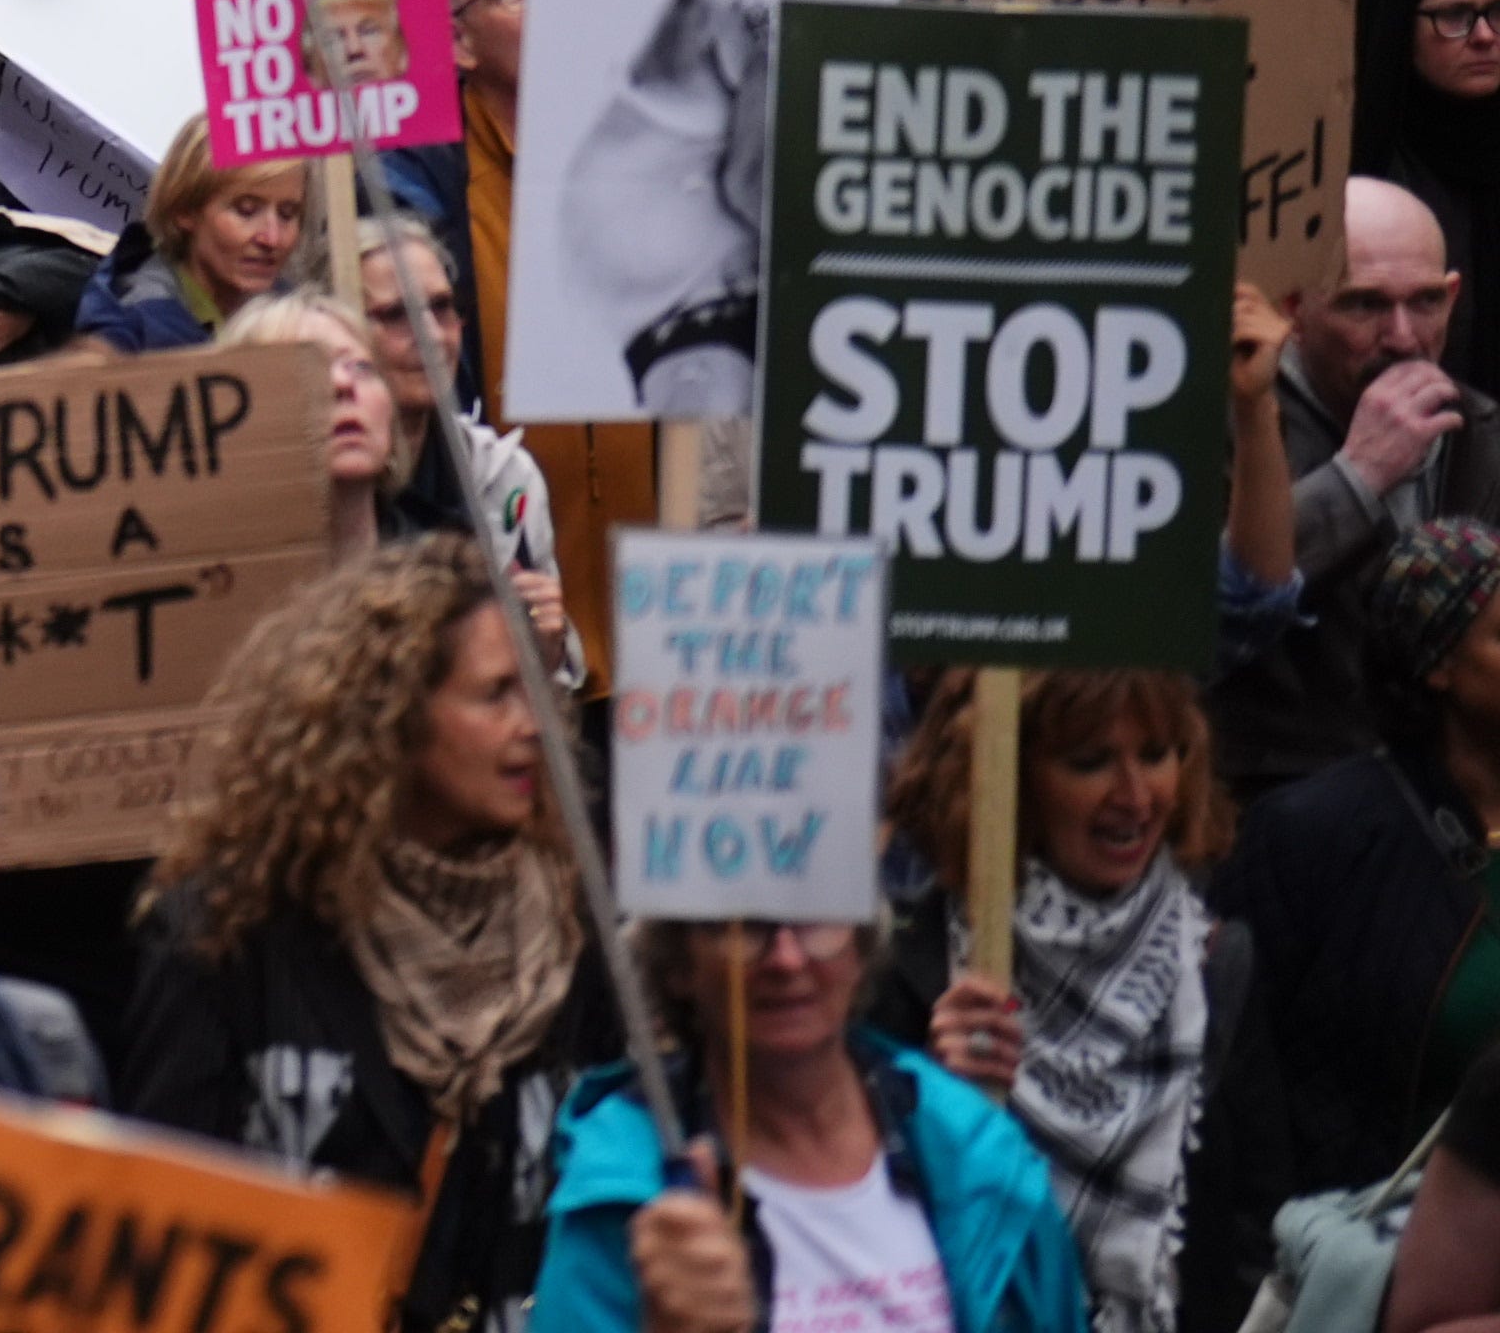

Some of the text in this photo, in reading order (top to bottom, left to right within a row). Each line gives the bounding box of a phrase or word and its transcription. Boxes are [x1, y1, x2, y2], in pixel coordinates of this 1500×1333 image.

[816, 61, 1198, 164] END THE
[814, 158, 1195, 242] GENOCIDE
[802, 295, 1187, 452] STOP
[111, 507, 158, 556] A
[800, 442, 1183, 562] TRUMP
[623, 556, 872, 620] DEPORT
[668, 628, 798, 676] THE
[617, 680, 853, 743] ORANGE
[644, 810, 825, 882] NOW
